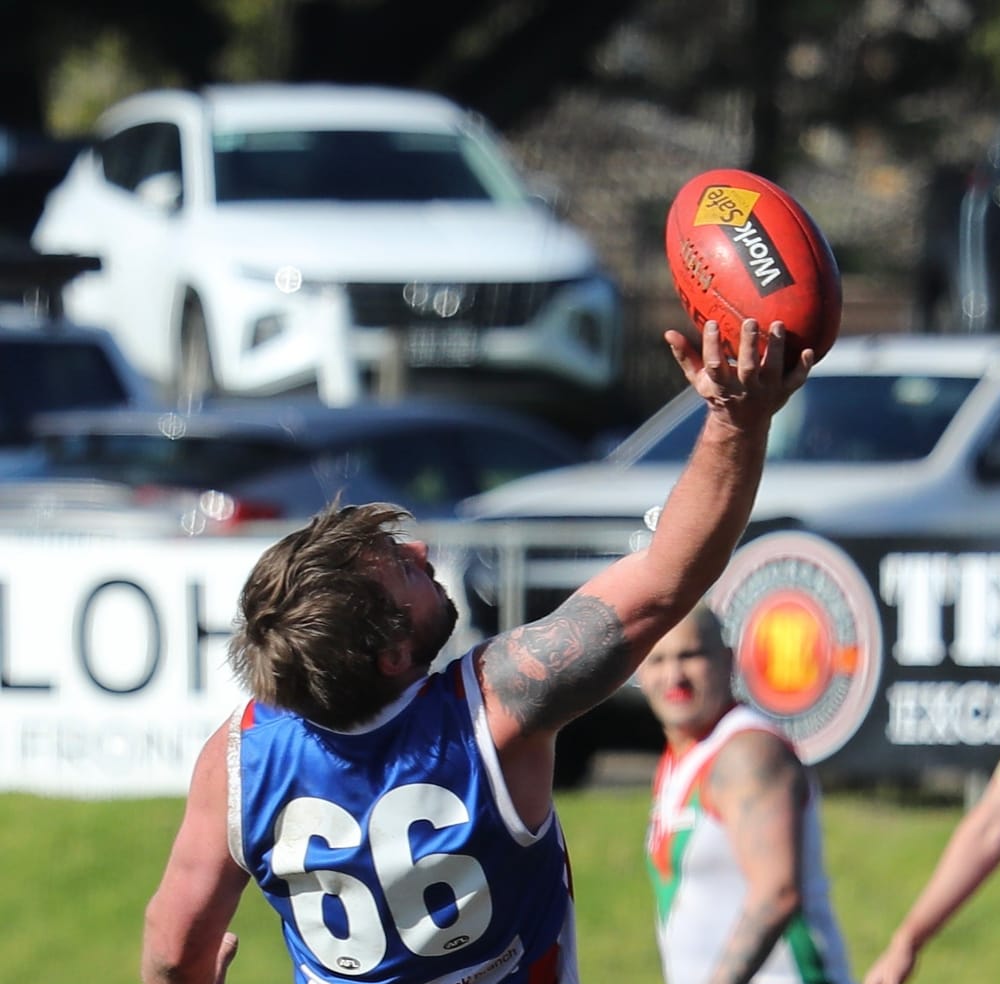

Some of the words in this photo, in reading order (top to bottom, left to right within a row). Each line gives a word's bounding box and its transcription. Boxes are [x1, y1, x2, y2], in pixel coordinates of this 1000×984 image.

[705, 189, 744, 223] Safe
[733, 221, 781, 287] Work
[271, 782, 493, 977] 66
